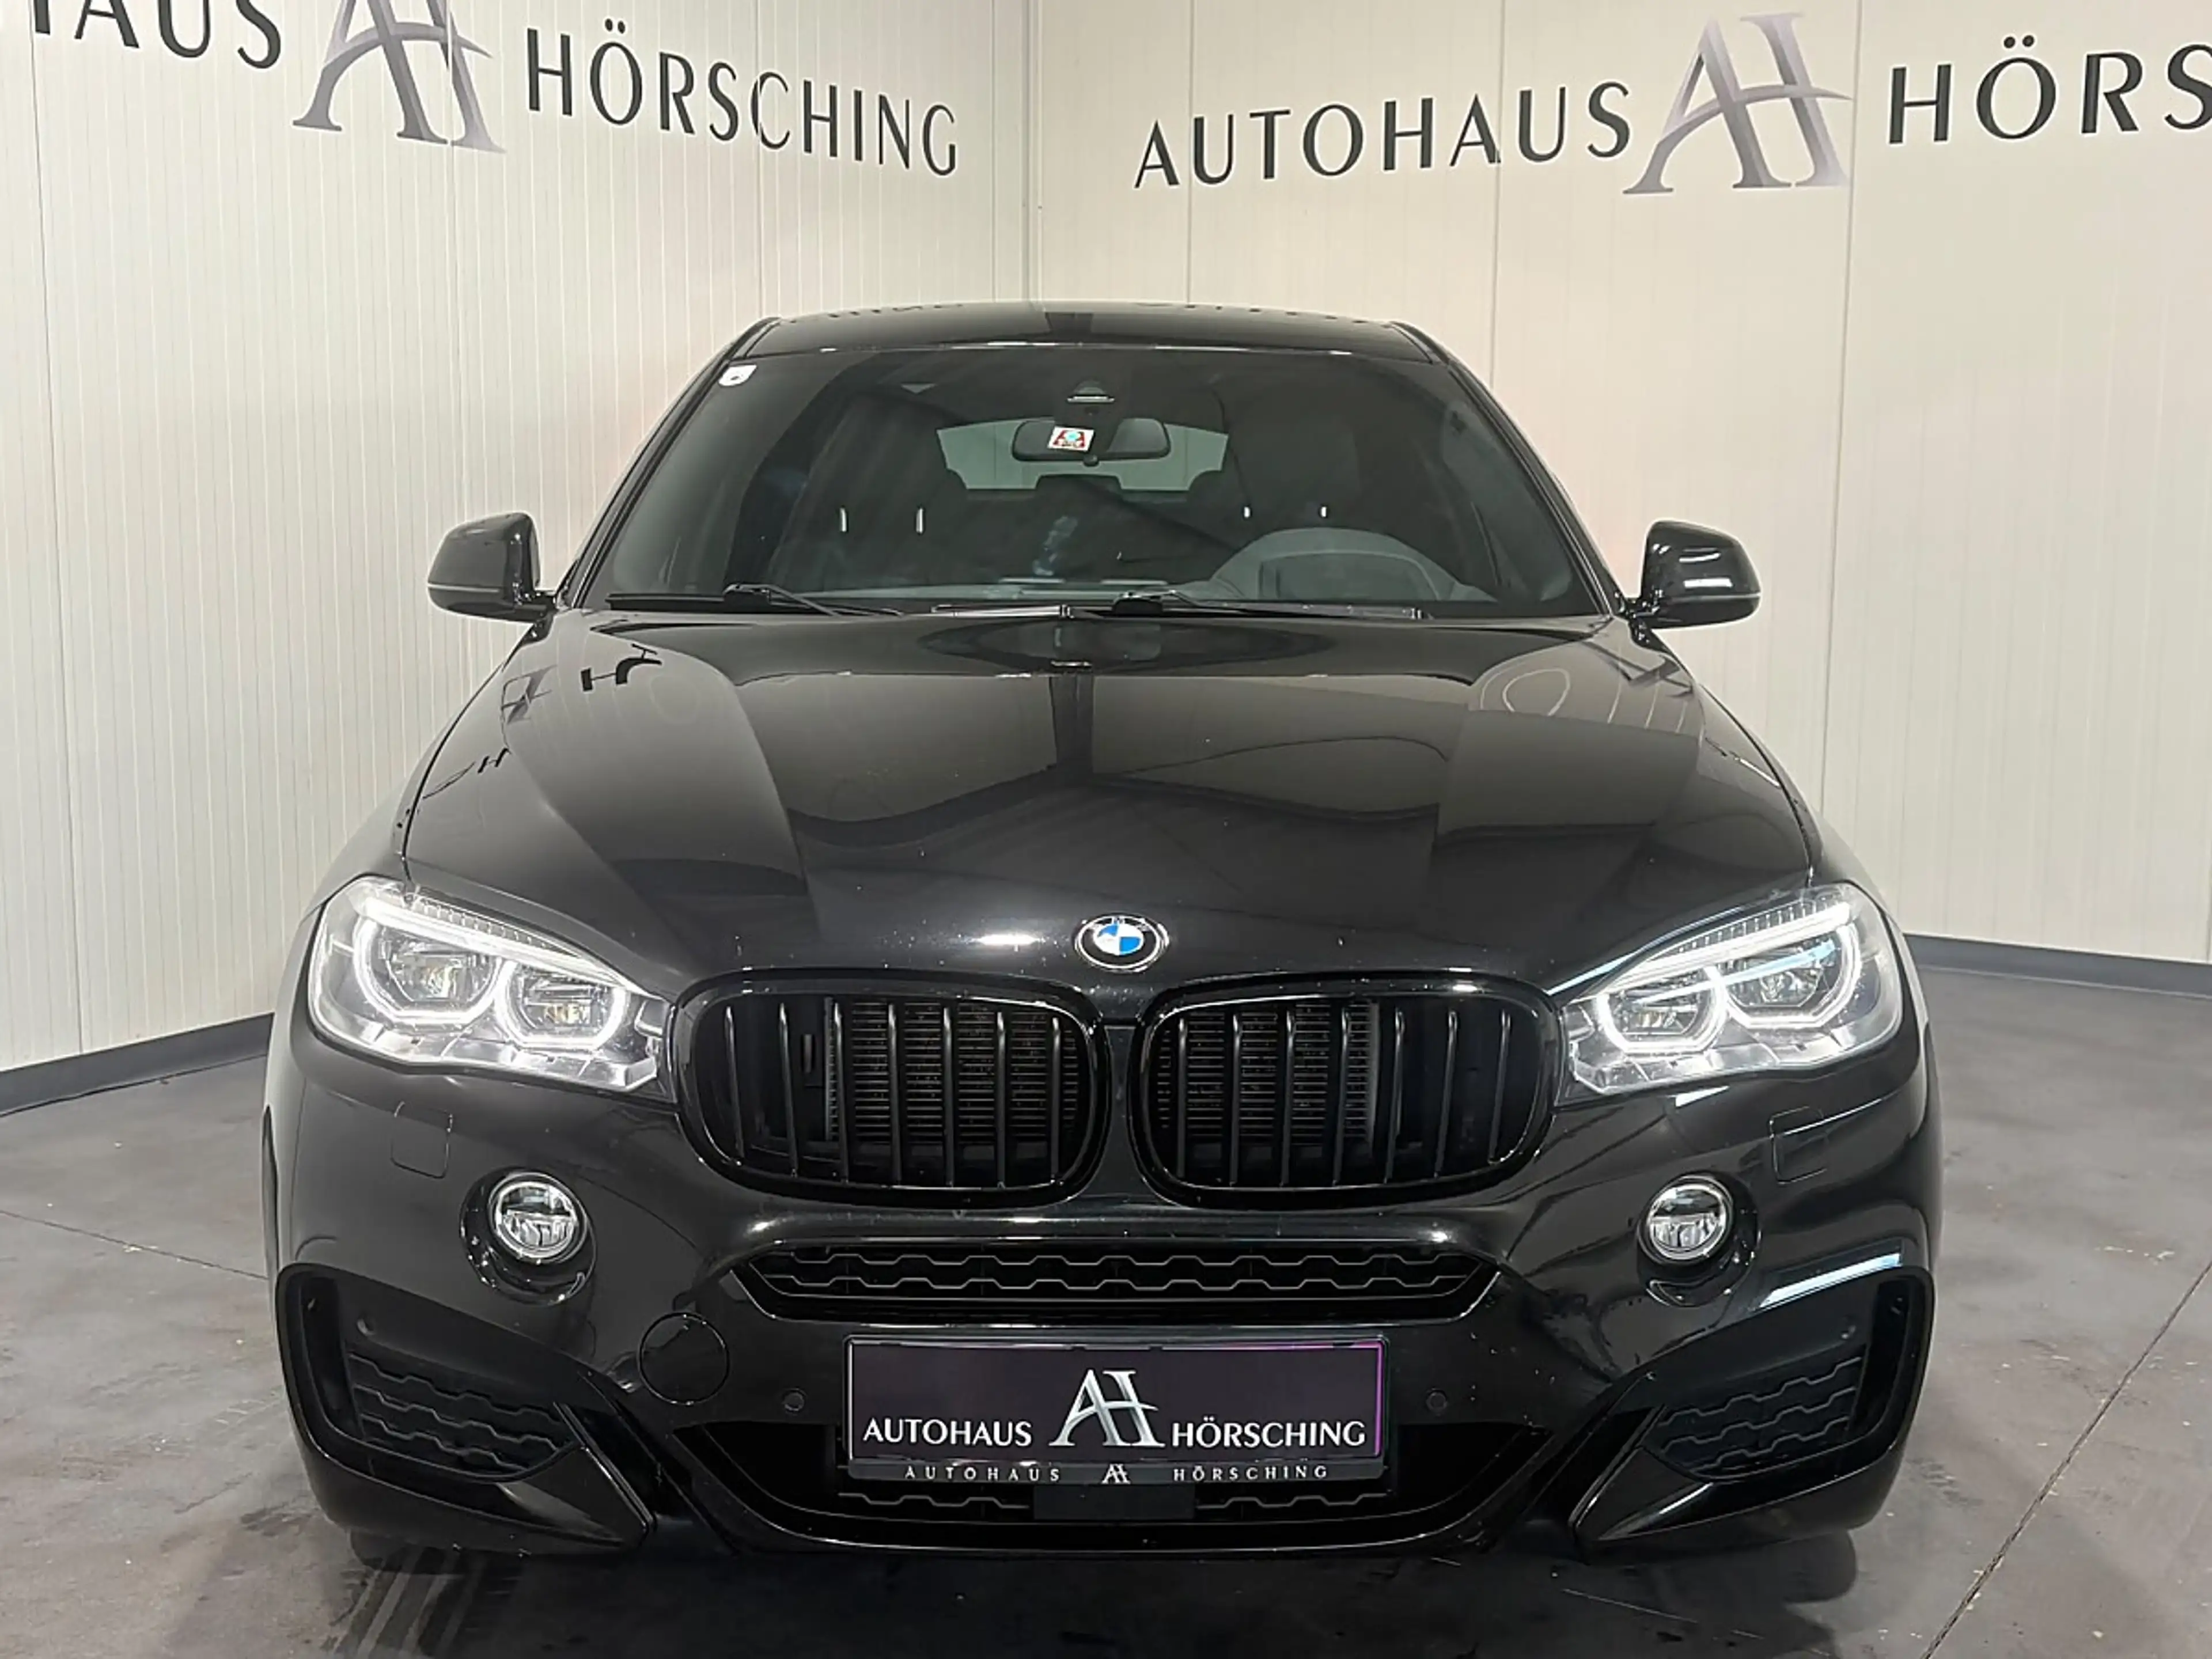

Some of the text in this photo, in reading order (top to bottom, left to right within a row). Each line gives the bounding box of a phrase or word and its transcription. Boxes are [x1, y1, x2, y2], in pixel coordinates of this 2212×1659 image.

[527, 18, 956, 176] HÖRSCHING
[1134, 81, 1631, 188] AUTOHAUS
[863, 1418, 1032, 1446] AUTOHAUS
[1172, 1415, 1366, 1448] HÖRSCHING
[905, 1466, 1060, 1482] AUTOHAUS
[1173, 1465, 1327, 1482] HÖRSCHING
